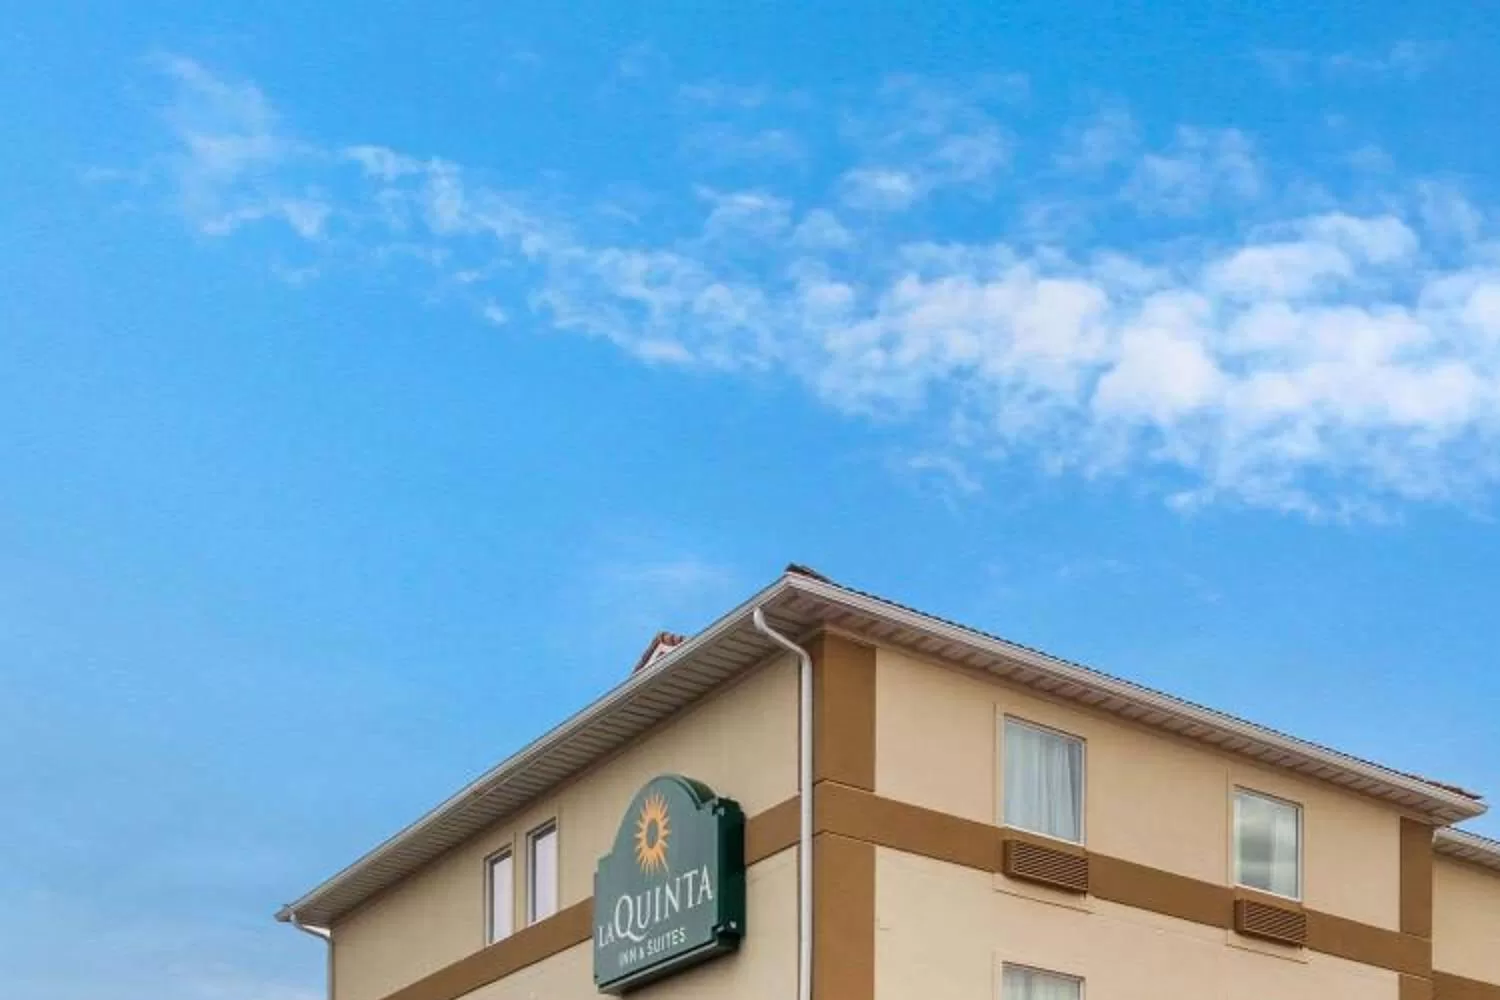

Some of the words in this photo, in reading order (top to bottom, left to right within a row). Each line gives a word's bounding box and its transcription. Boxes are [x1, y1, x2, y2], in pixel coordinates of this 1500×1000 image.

[598, 924, 616, 948] LA
[615, 864, 713, 943] QUINTA
[619, 946, 637, 967] INN
[647, 926, 687, 957] SUITES
